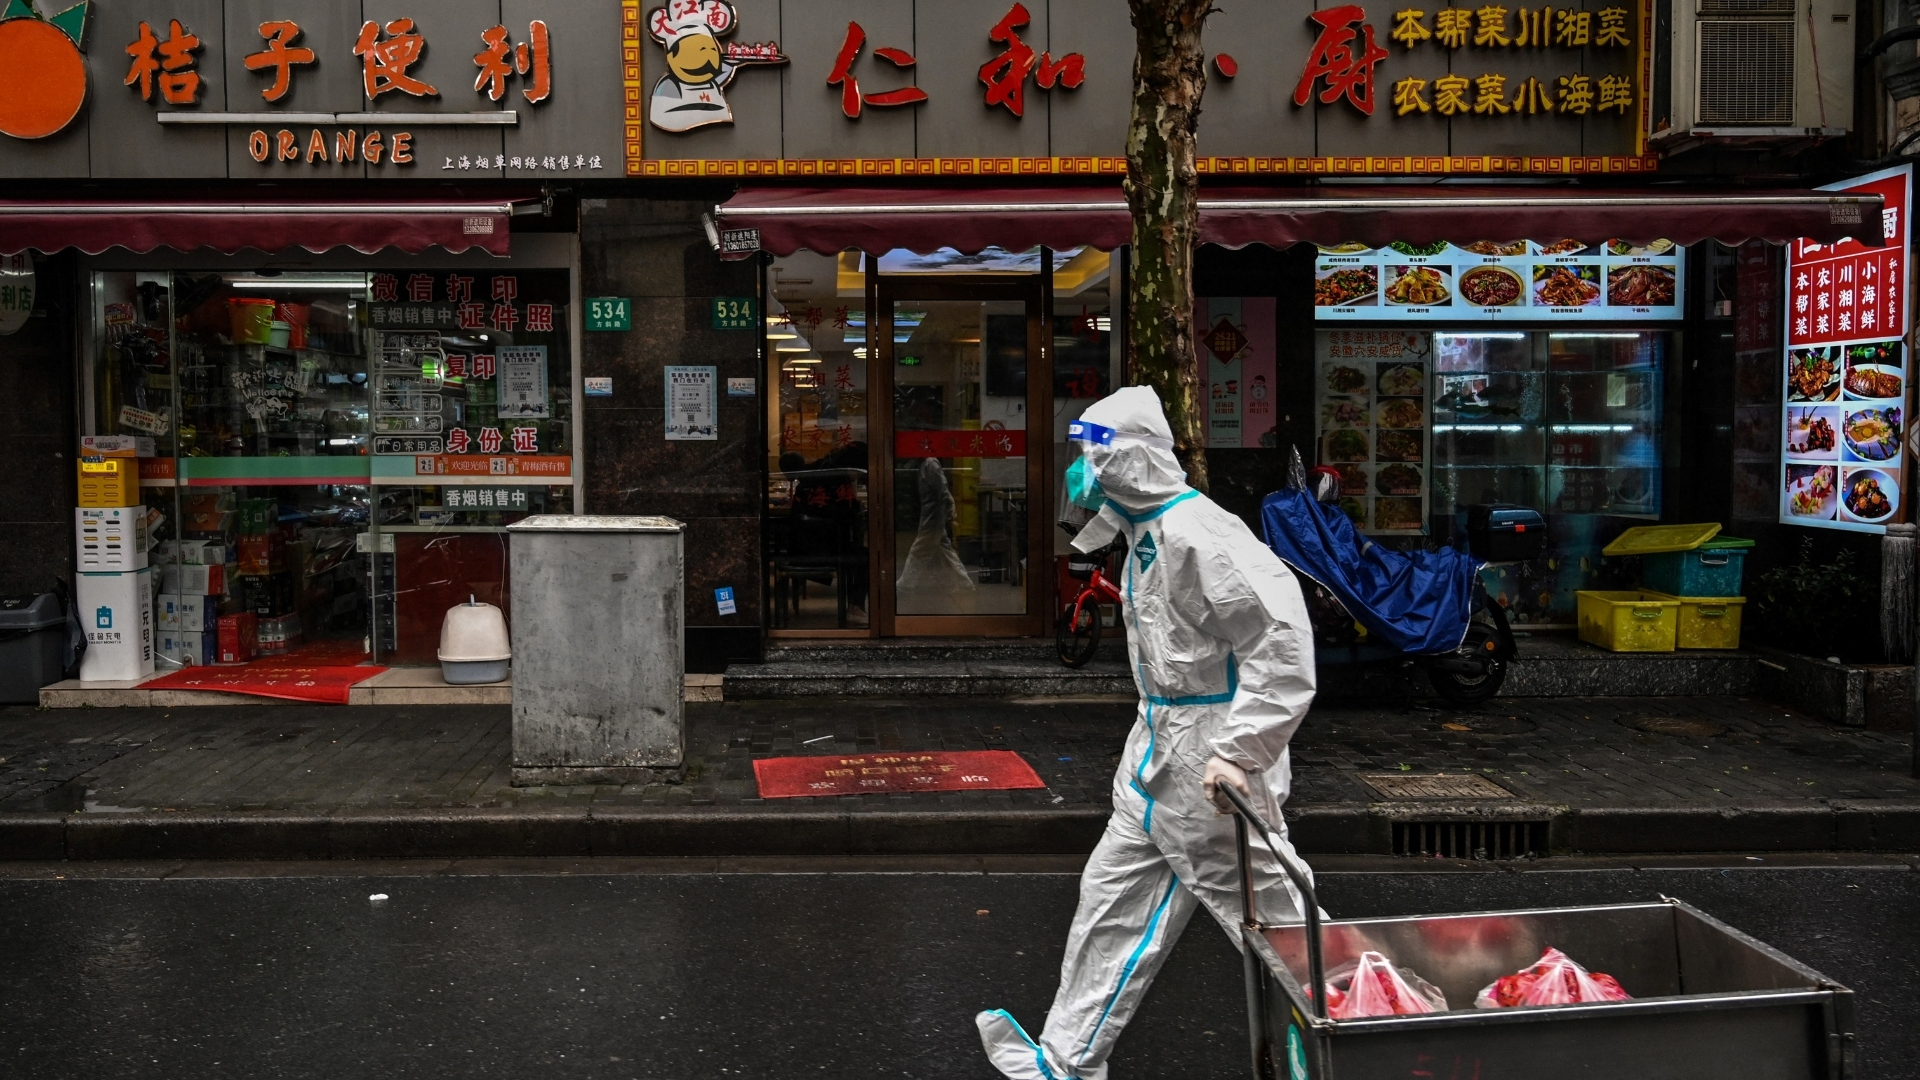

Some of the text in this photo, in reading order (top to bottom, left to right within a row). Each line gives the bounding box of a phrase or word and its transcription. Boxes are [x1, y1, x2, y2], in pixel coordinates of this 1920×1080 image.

[653, 0, 729, 36] 大江南
[1391, 5, 1631, 48] 本帮菜川湘菜
[124, 18, 551, 104] 桔子便利
[1392, 73, 1633, 116] 农家菜小海鲜
[248, 129, 415, 164] ORANGE
[441, 155, 603, 172] 上海烟草网络销售单位
[370, 273, 518, 301] 微信打印
[1838, 265, 1853, 332] 川湘菜
[1861, 261, 1877, 329] 小海鲜
[592, 301, 625, 319] 534
[717, 301, 750, 319] 534
[1795, 272, 1810, 336] 本帮菜
[1816, 267, 1831, 334] 农家菜
[372, 306, 453, 323] 香烟销售中
[456, 303, 553, 332] 证件照
[776, 305, 854, 330] 本帮菜
[1329, 331, 1403, 344] 冬季滋补锅仔
[1329, 345, 1403, 357] 安徽六安咸货
[445, 353, 497, 379] 复印
[779, 364, 855, 389] 川湘菜
[393, 440, 440, 452] 日常用品
[446, 427, 538, 453] 身份证
[778, 424, 857, 449] 农家菜
[451, 460, 488, 471] 欢迎光临
[521, 461, 566, 472] 青梅酒有售
[445, 489, 527, 507] 香烟销售中
[88, 632, 121, 640] 怪兽充电
